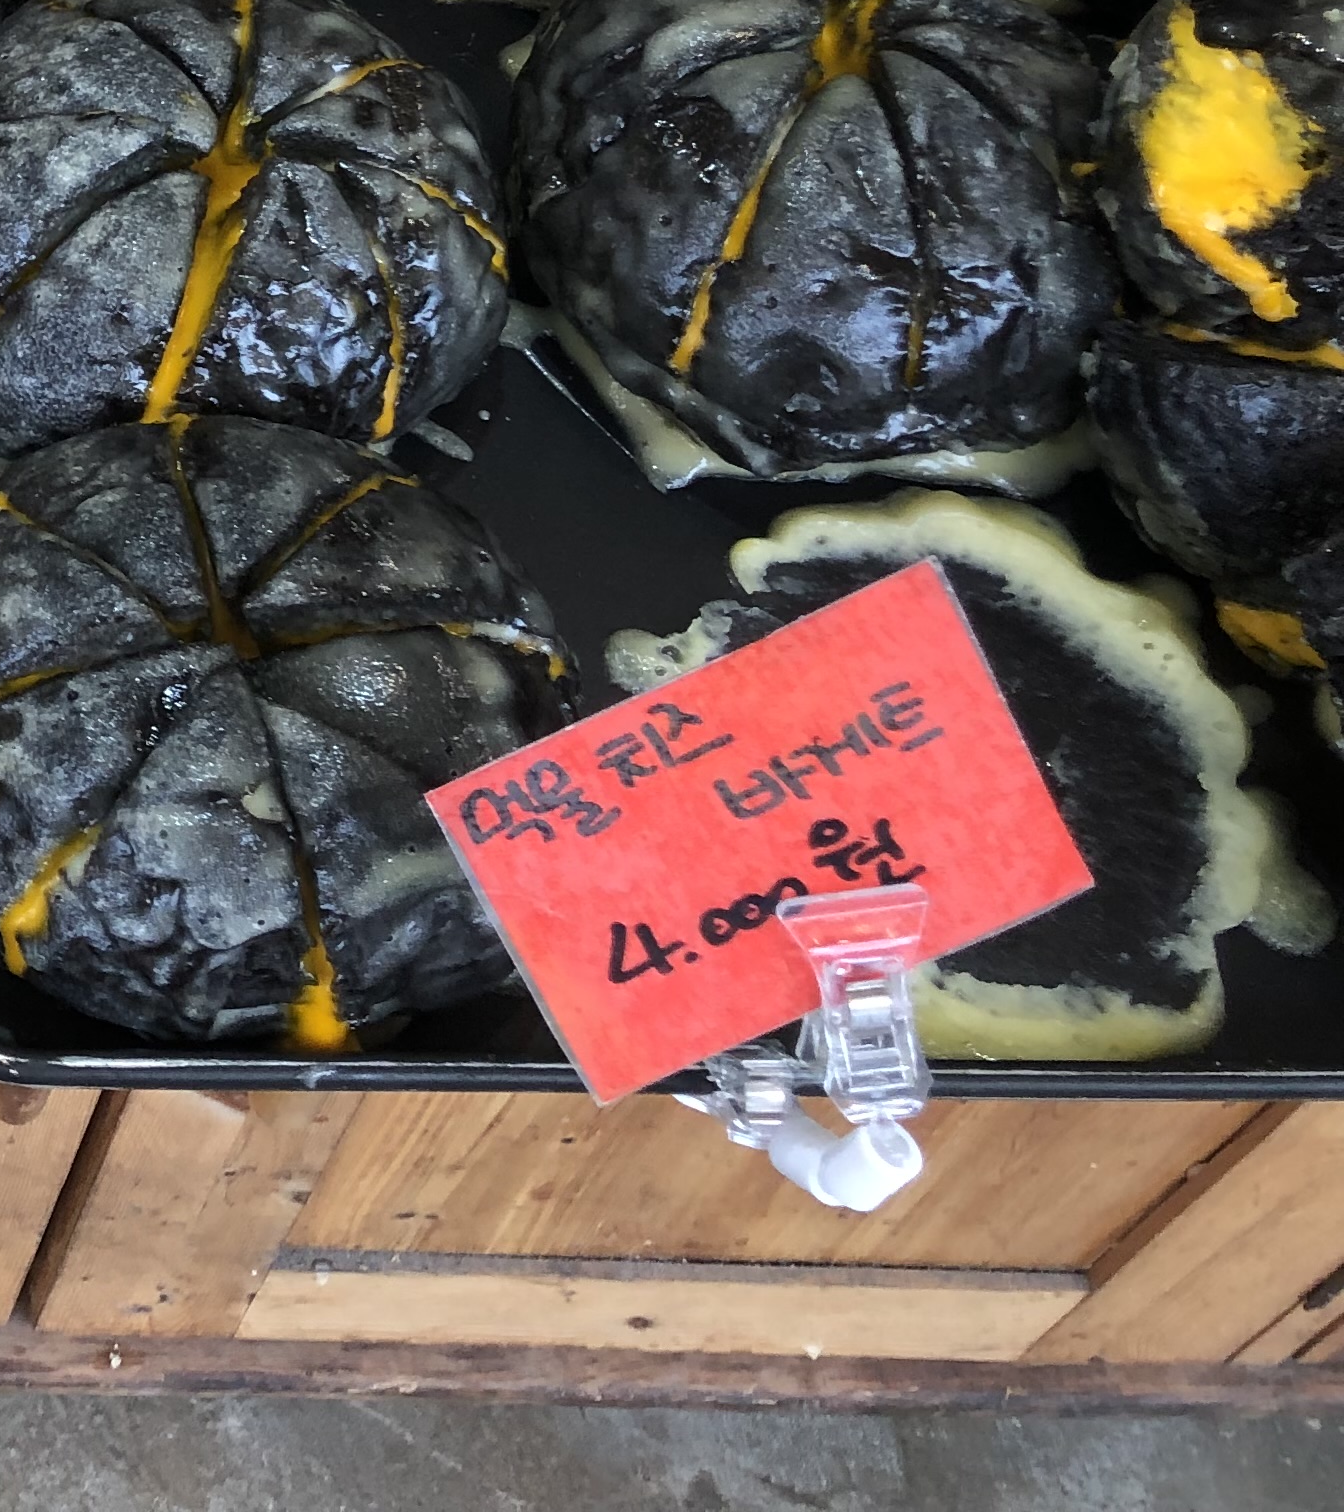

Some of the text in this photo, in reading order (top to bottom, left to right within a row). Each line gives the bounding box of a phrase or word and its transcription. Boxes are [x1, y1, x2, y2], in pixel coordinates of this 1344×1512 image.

[458, 701, 736, 846] 먹물 치즈
[710, 680, 947, 821] 바게트
